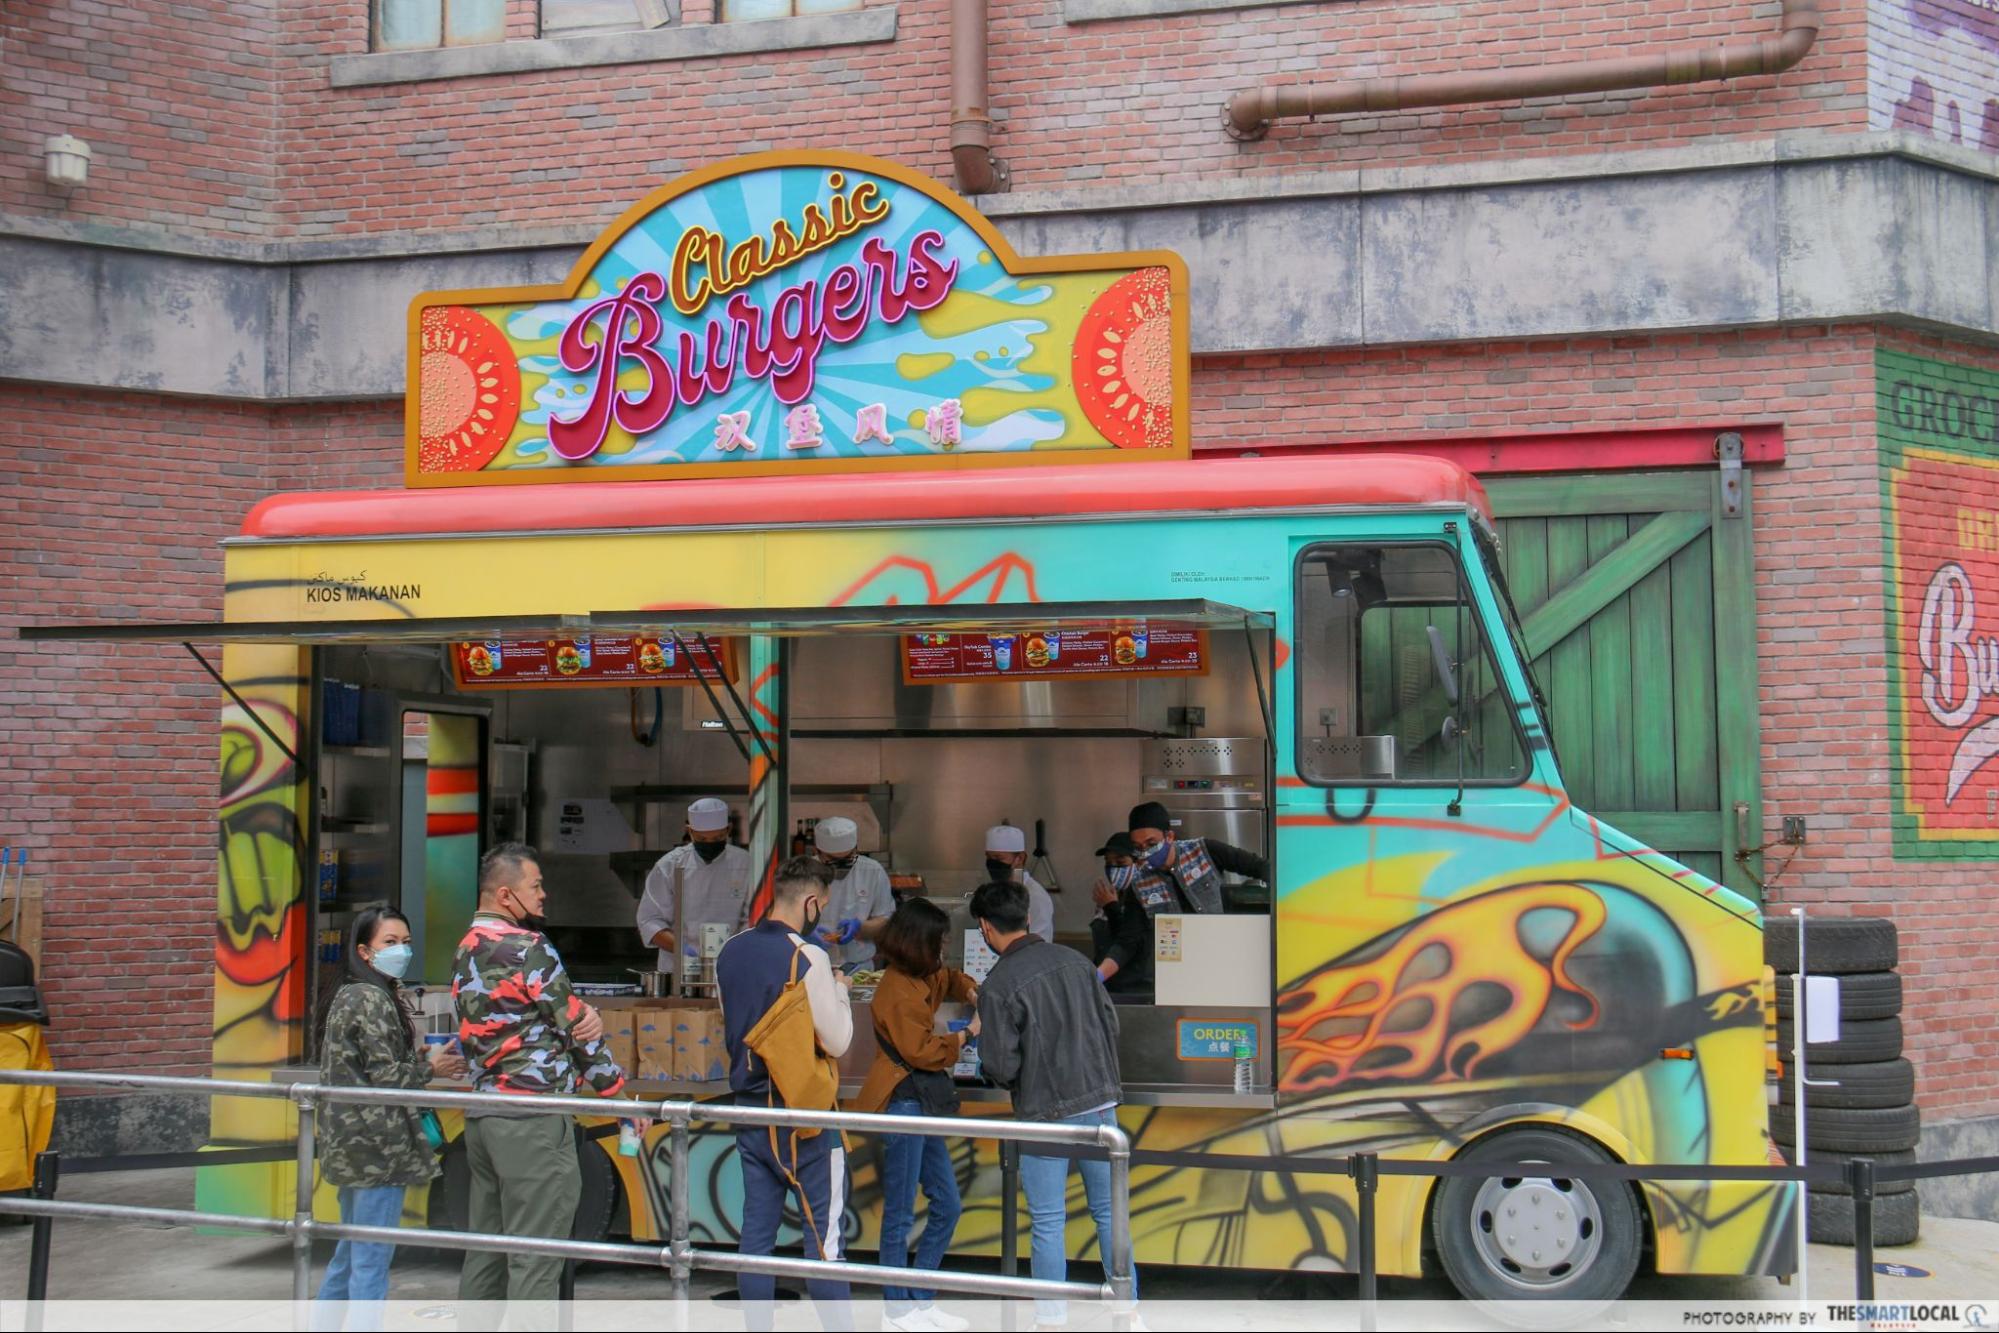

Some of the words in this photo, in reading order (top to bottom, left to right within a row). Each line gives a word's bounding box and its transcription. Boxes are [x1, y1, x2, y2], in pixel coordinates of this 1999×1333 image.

[668, 170, 891, 317] Classic
[547, 228, 961, 460] Burgers
[714, 398, 963, 452] 汉堡风情
[1957, 507, 1999, 553] DR
[307, 587, 341, 603] KIOS
[346, 584, 421, 601] MAKANAN
